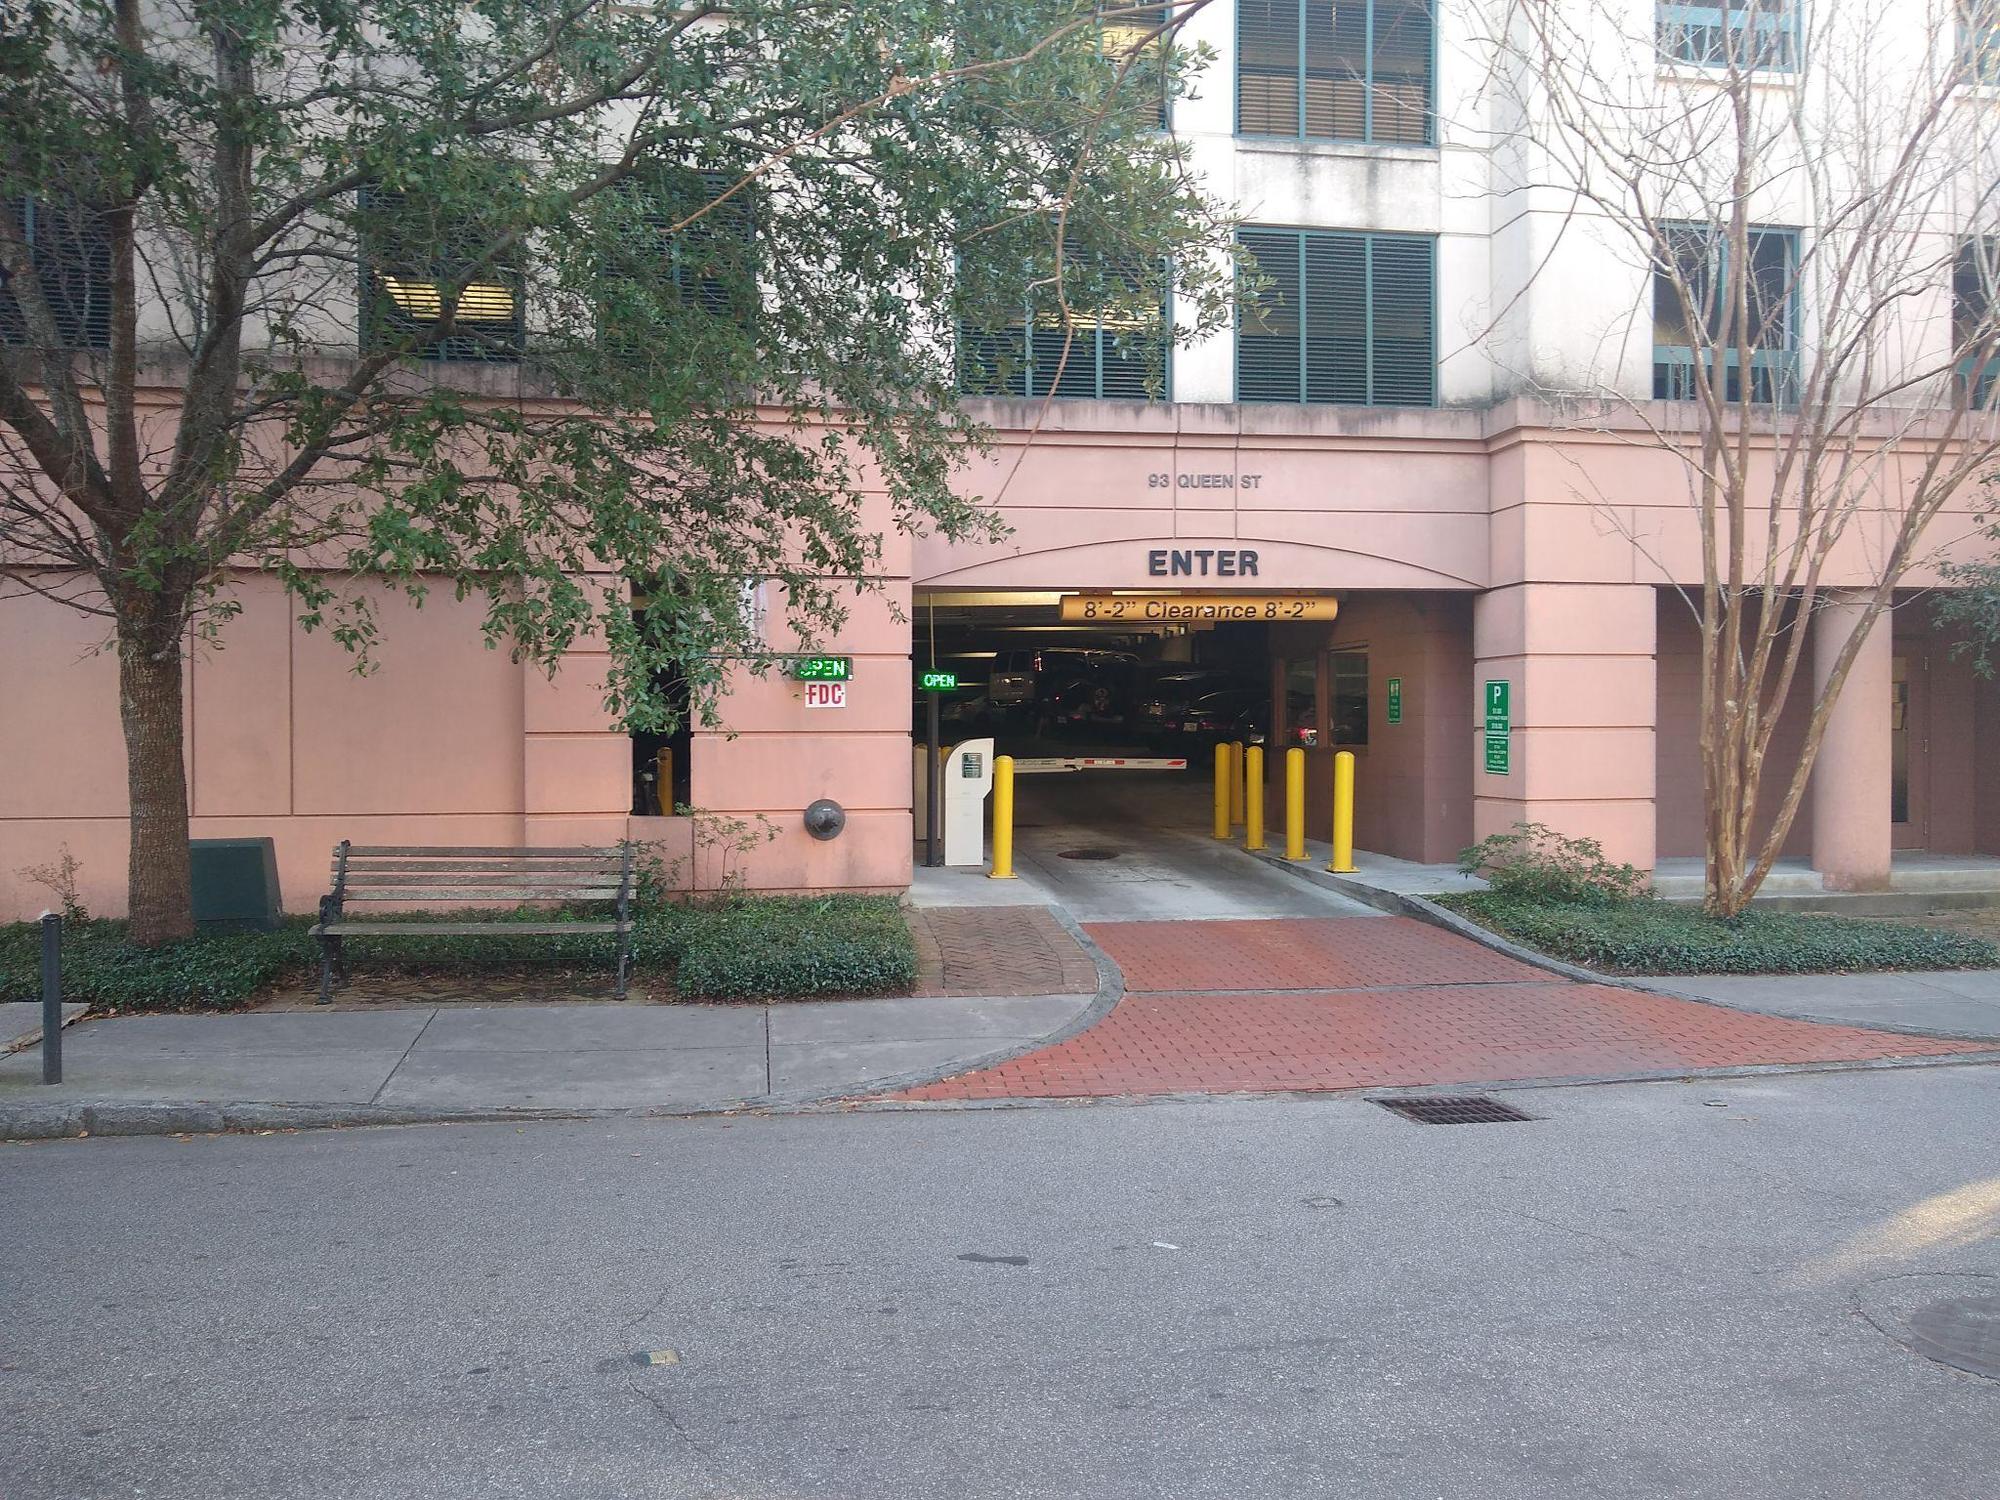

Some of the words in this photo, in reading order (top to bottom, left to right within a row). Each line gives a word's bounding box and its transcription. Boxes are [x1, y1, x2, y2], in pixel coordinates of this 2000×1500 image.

[1148, 473, 1170, 488] 93
[1177, 474, 1234, 489] QUEEN
[1240, 475, 1262, 489] ST
[1148, 550, 1259, 576] ENTER
[1145, 601, 1257, 618] Clearance
[923, 674, 955, 687] OPEN
[808, 683, 842, 705] FDC
[1494, 685, 1501, 704] P
